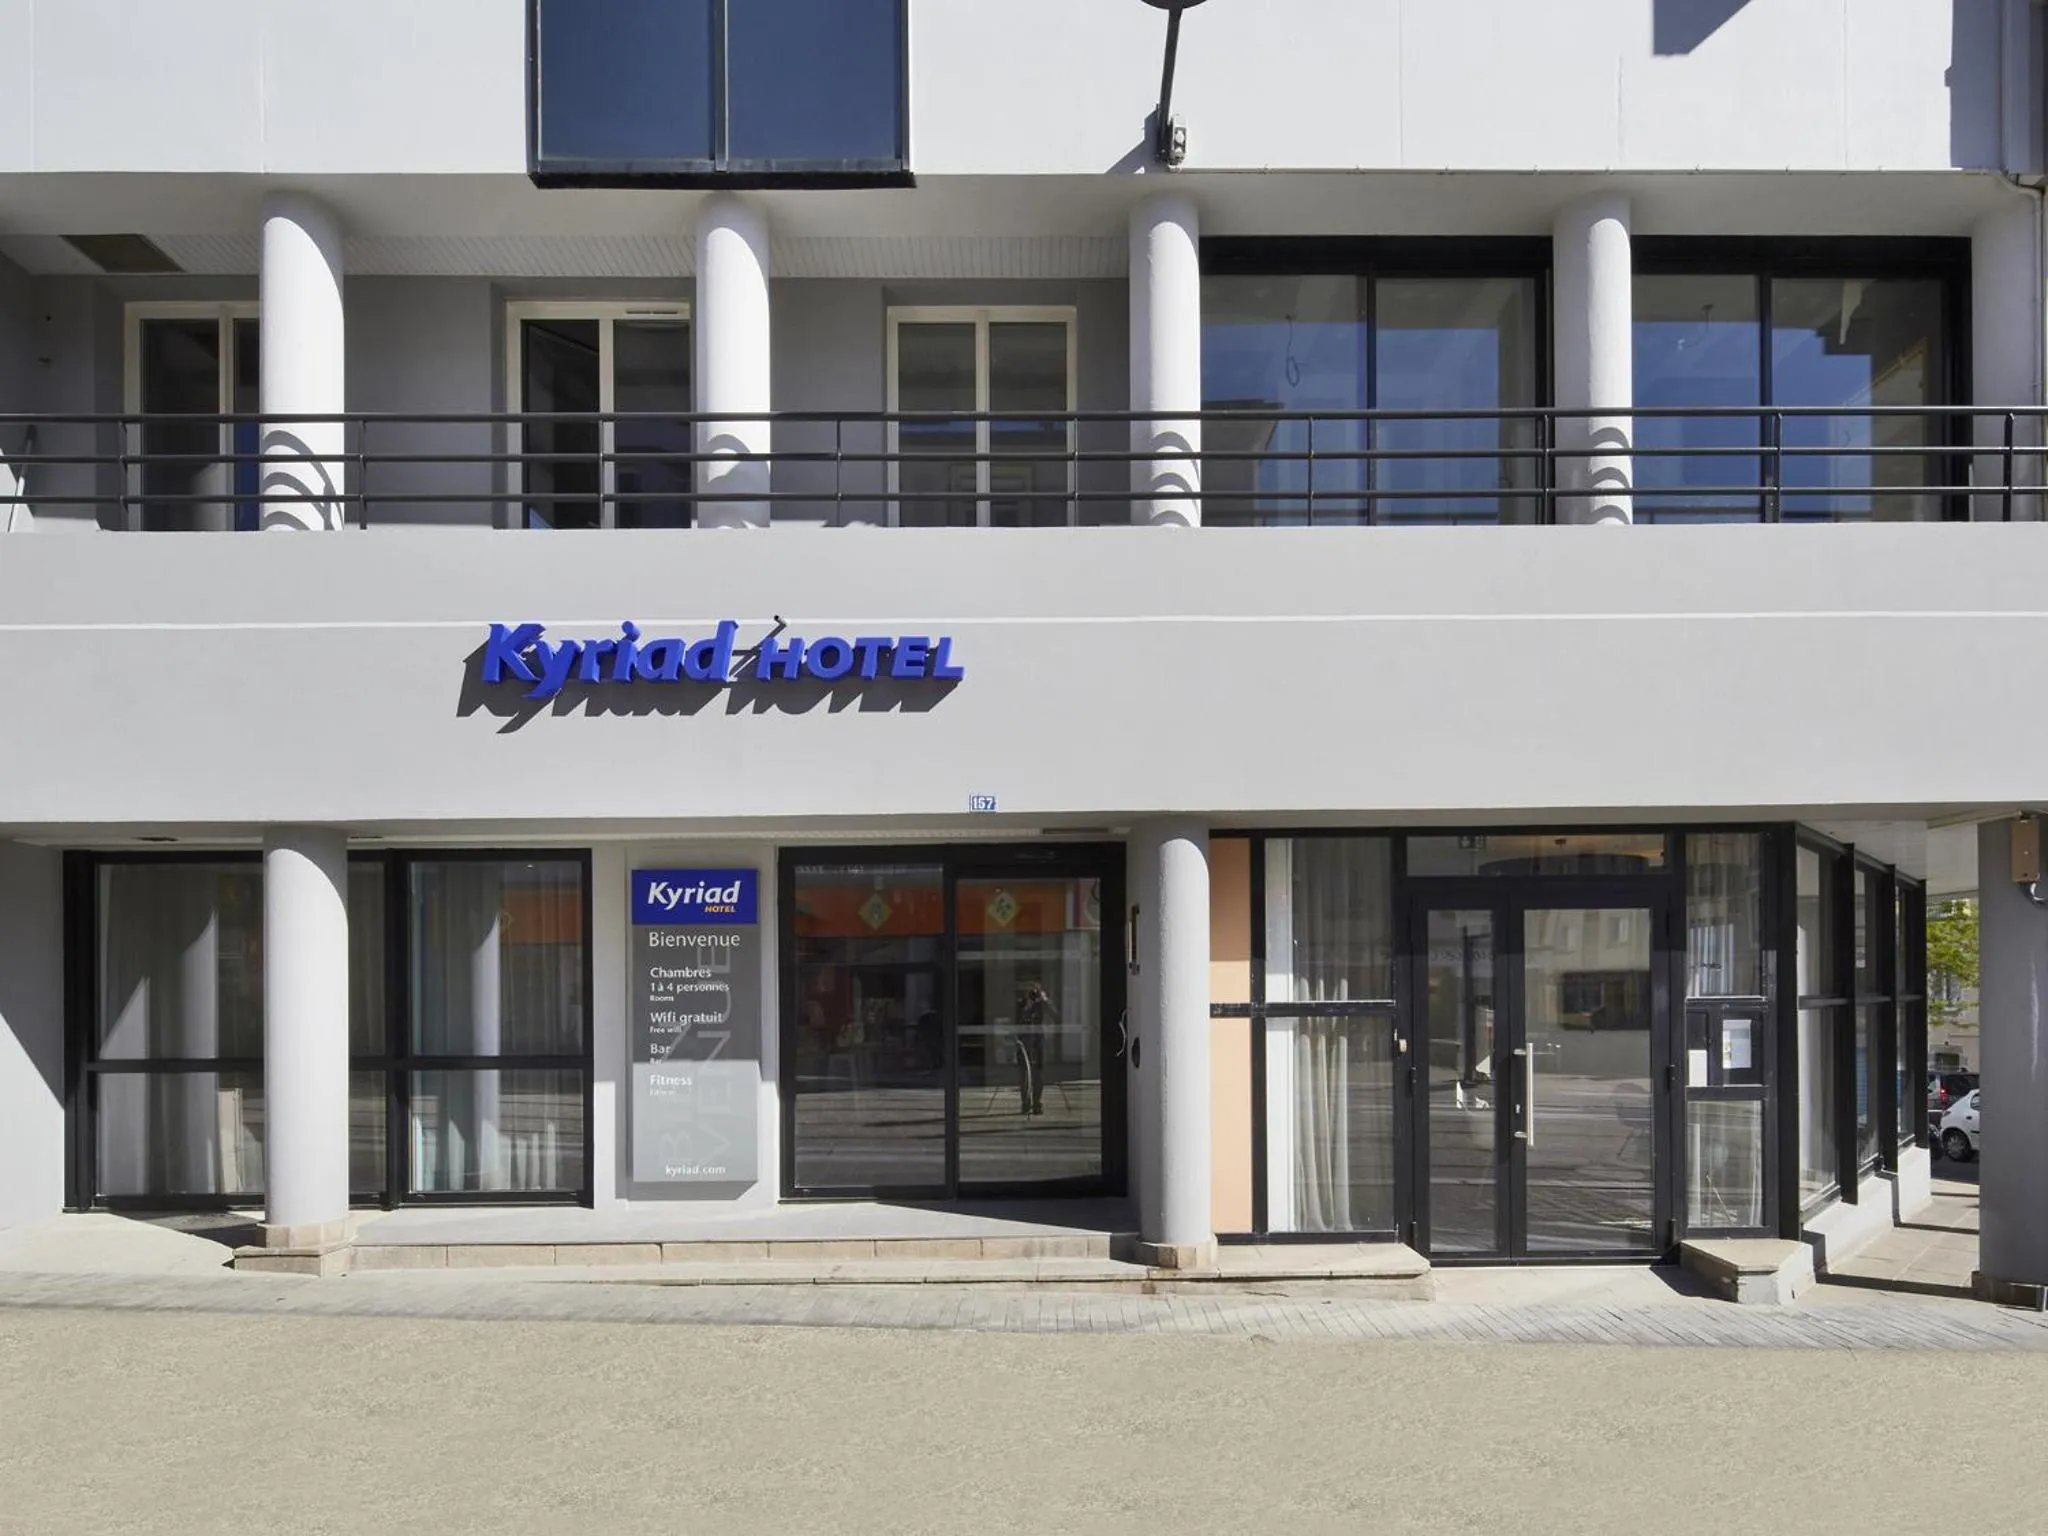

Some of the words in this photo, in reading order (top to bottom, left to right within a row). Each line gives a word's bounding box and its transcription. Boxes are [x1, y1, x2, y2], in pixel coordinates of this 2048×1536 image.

[481, 620, 738, 699] Kyriad
[757, 637, 964, 681] HOTEL
[973, 797, 993, 809] 157
[648, 881, 741, 910] Kyriad
[704, 905, 736, 913] HOTEL
[649, 932, 741, 948] Bienvenue
[650, 967, 712, 979] Chambres
[667, 982, 674, 992] 4
[676, 983, 730, 994] personnes
[650, 1012, 676, 1023] Wifi
[679, 1012, 723, 1026] gratuit
[650, 1043, 671, 1054] Bar
[650, 1074, 692, 1086] Fitness
[665, 1164, 727, 1177] kyriad.com
